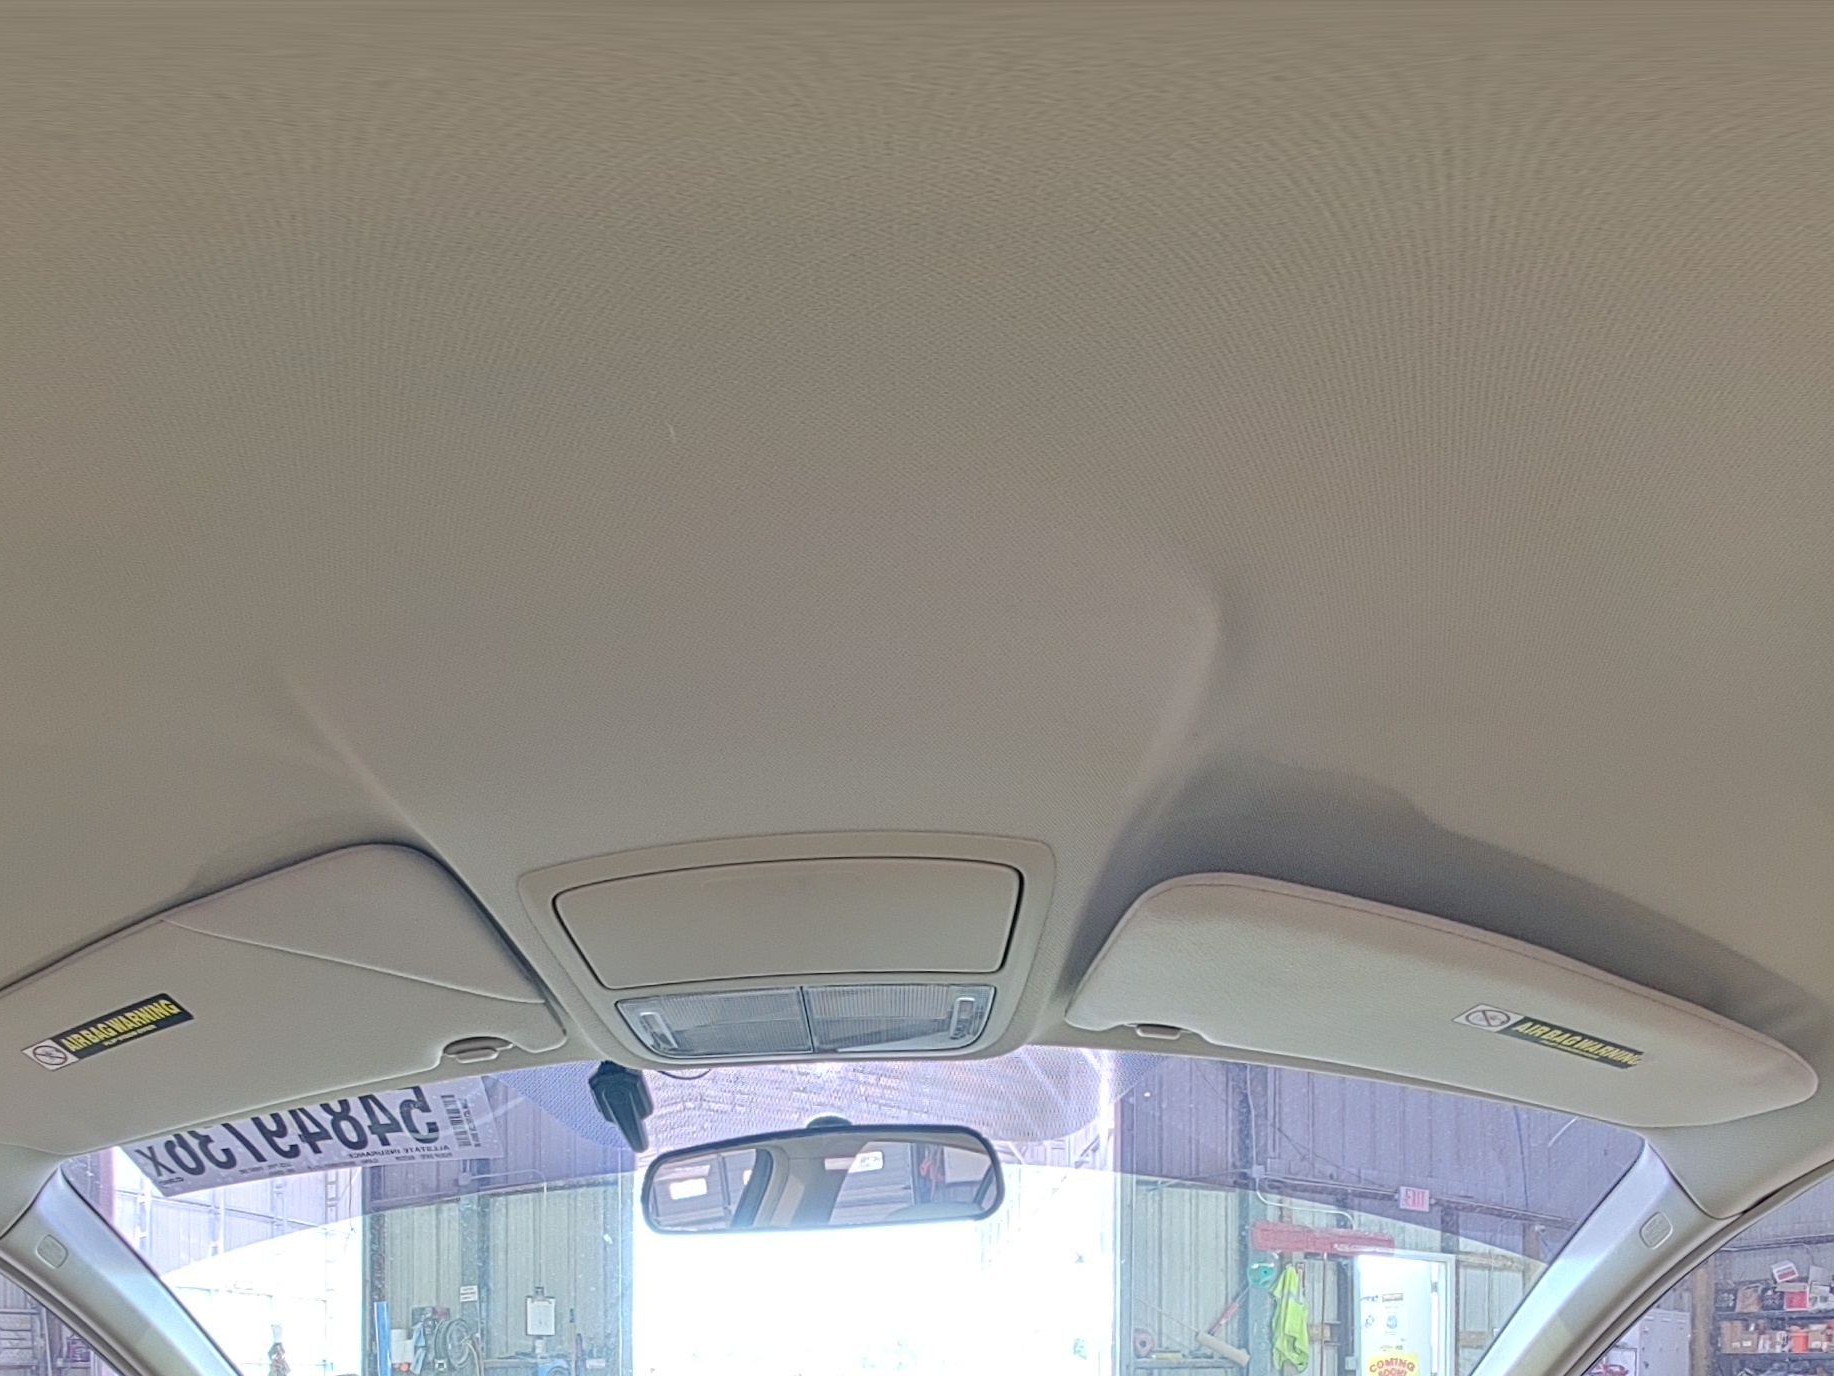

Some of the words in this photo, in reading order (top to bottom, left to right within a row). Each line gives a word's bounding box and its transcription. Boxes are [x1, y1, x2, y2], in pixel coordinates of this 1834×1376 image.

[61, 1024, 114, 1052] AIRBAG
[105, 999, 182, 1036] WARNING
[1514, 1021, 1581, 1046] AIRBAG
[1576, 1038, 1643, 1066] WARNING
[1404, 1188, 1425, 1208] EXIT
[1369, 1357, 1415, 1373] COMING
